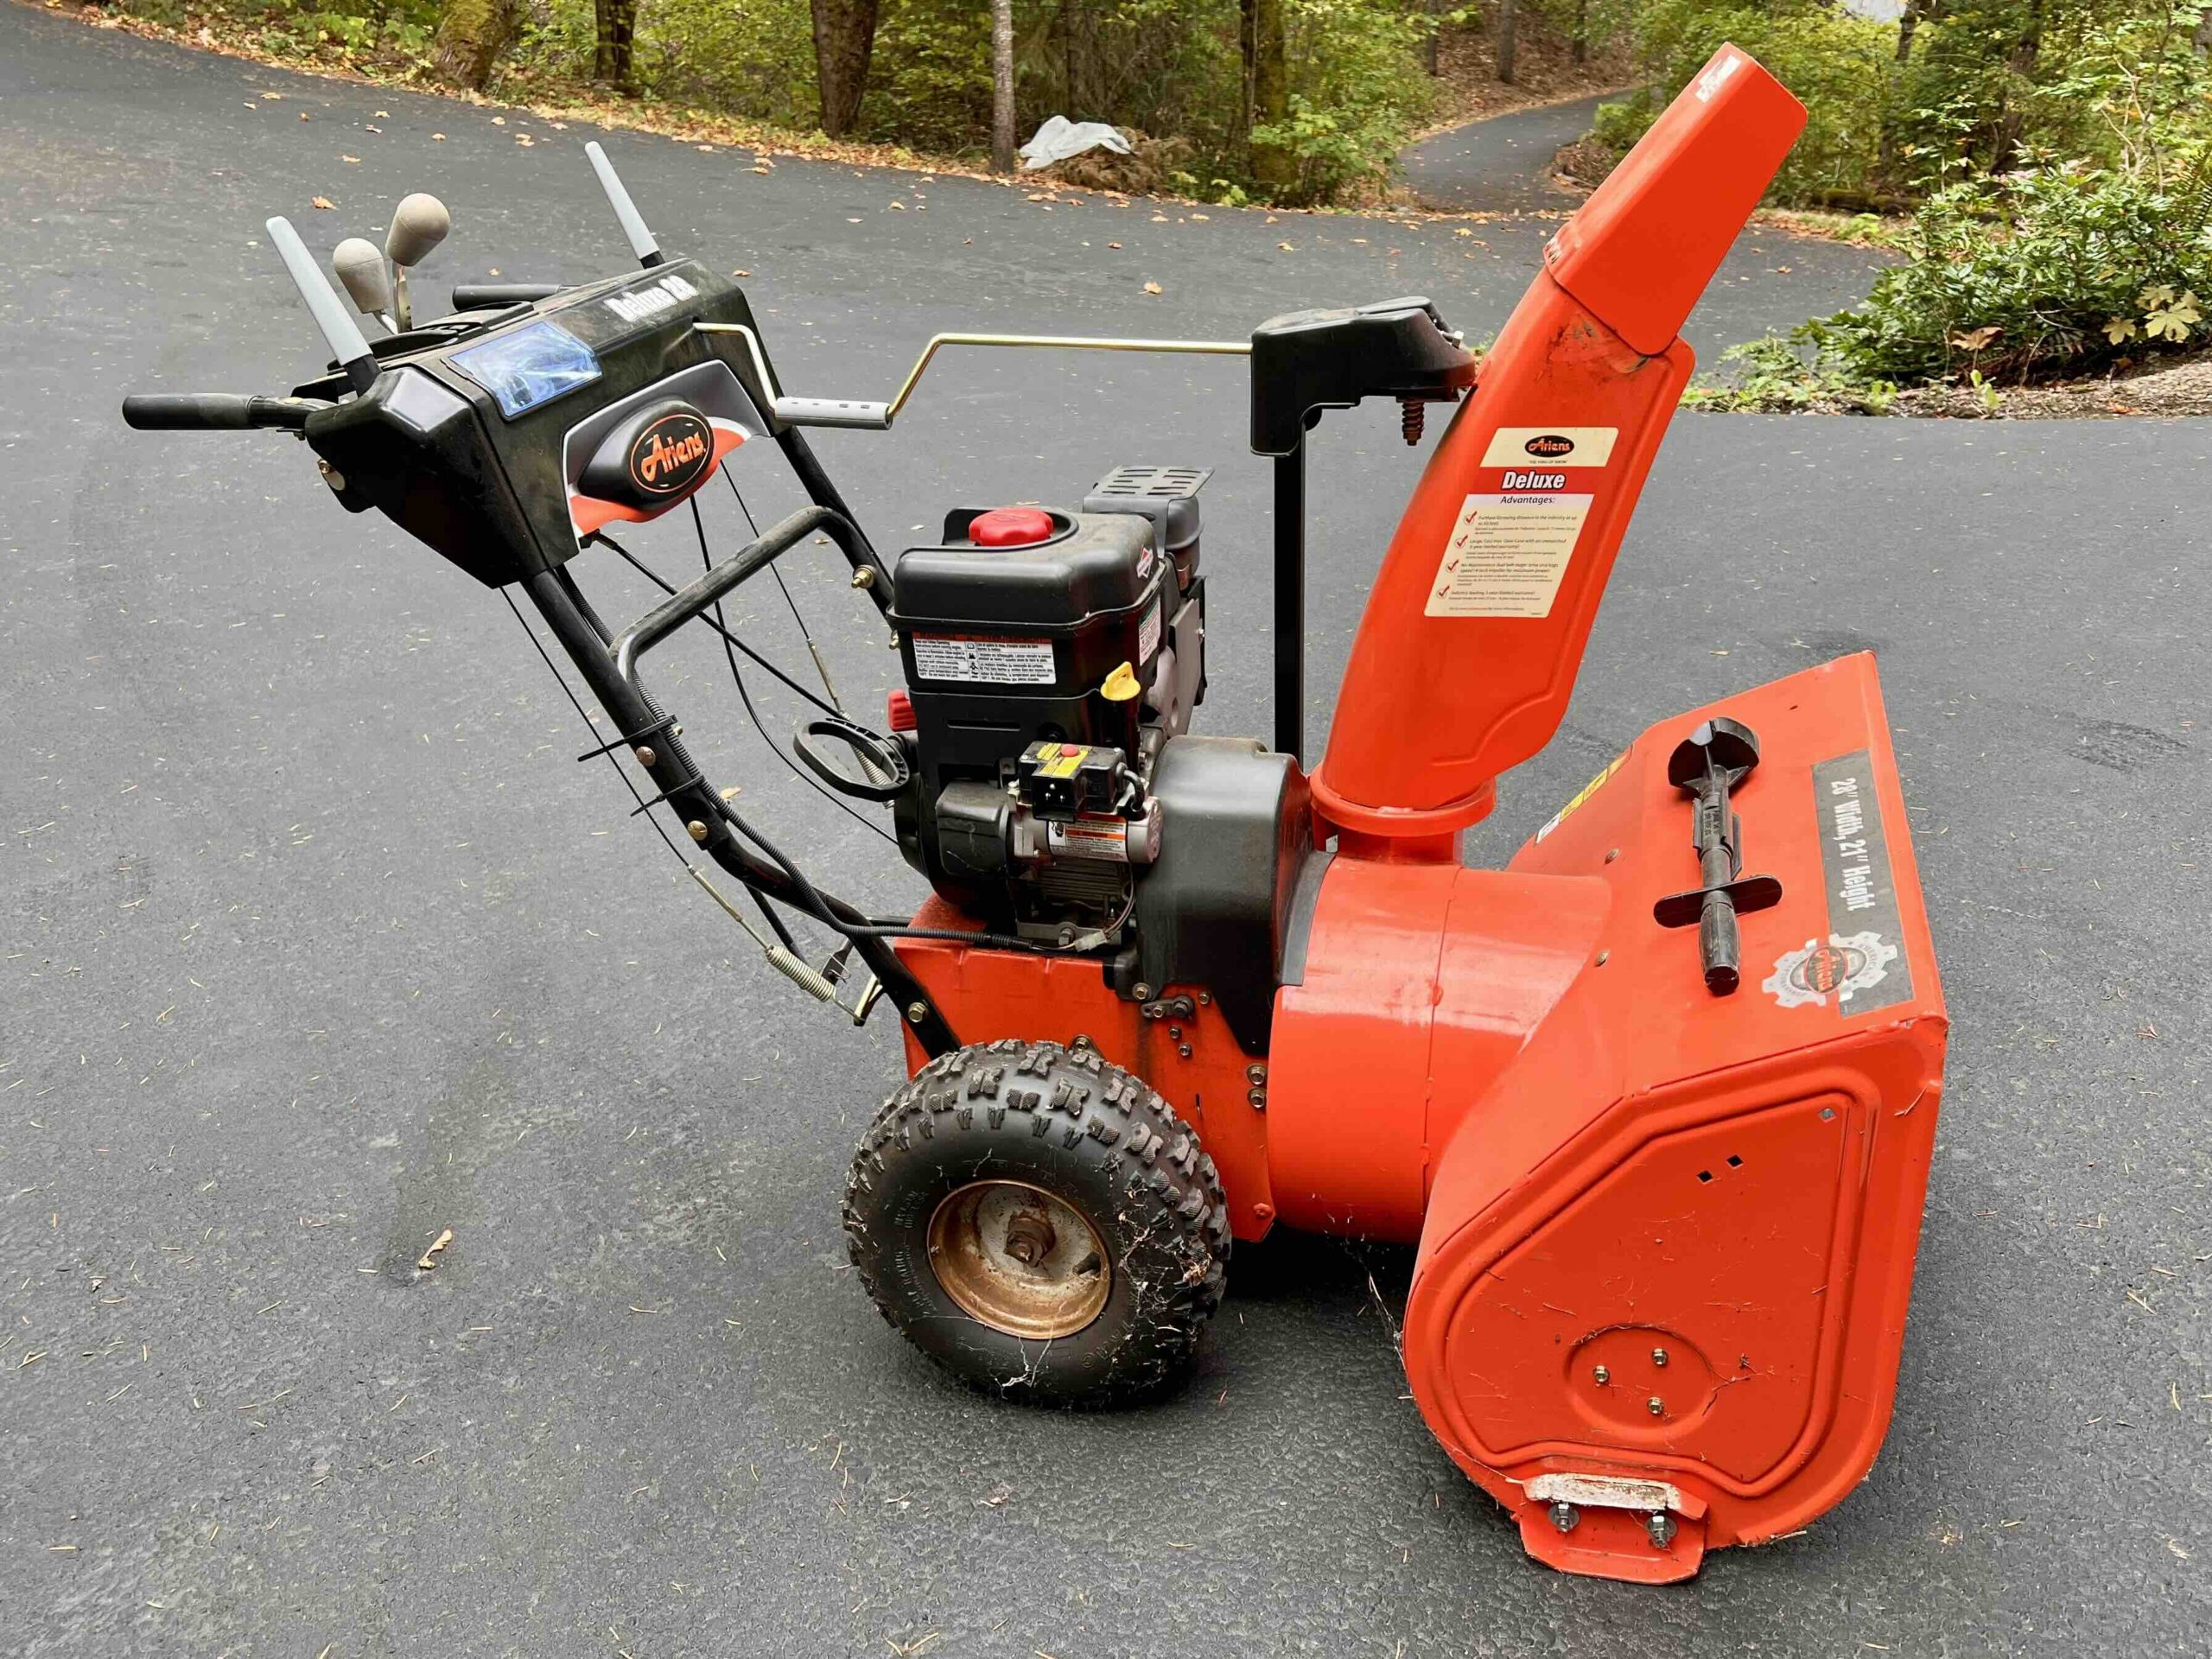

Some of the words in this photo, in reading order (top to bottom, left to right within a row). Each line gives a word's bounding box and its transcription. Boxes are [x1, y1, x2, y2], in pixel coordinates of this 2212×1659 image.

[603, 287, 677, 321] Deluxe
[641, 431, 704, 481] Ariens
[1528, 438, 1571, 452] Ariens
[1501, 471, 1566, 490] Deluxe
[1500, 495, 1556, 505] Advantages:
[1829, 777, 1859, 798] 28"
[1830, 798, 1864, 840] Width,
[1837, 839, 1869, 861] 21"
[1837, 864, 1876, 912] Height
[1813, 949, 1841, 993] Ariens
